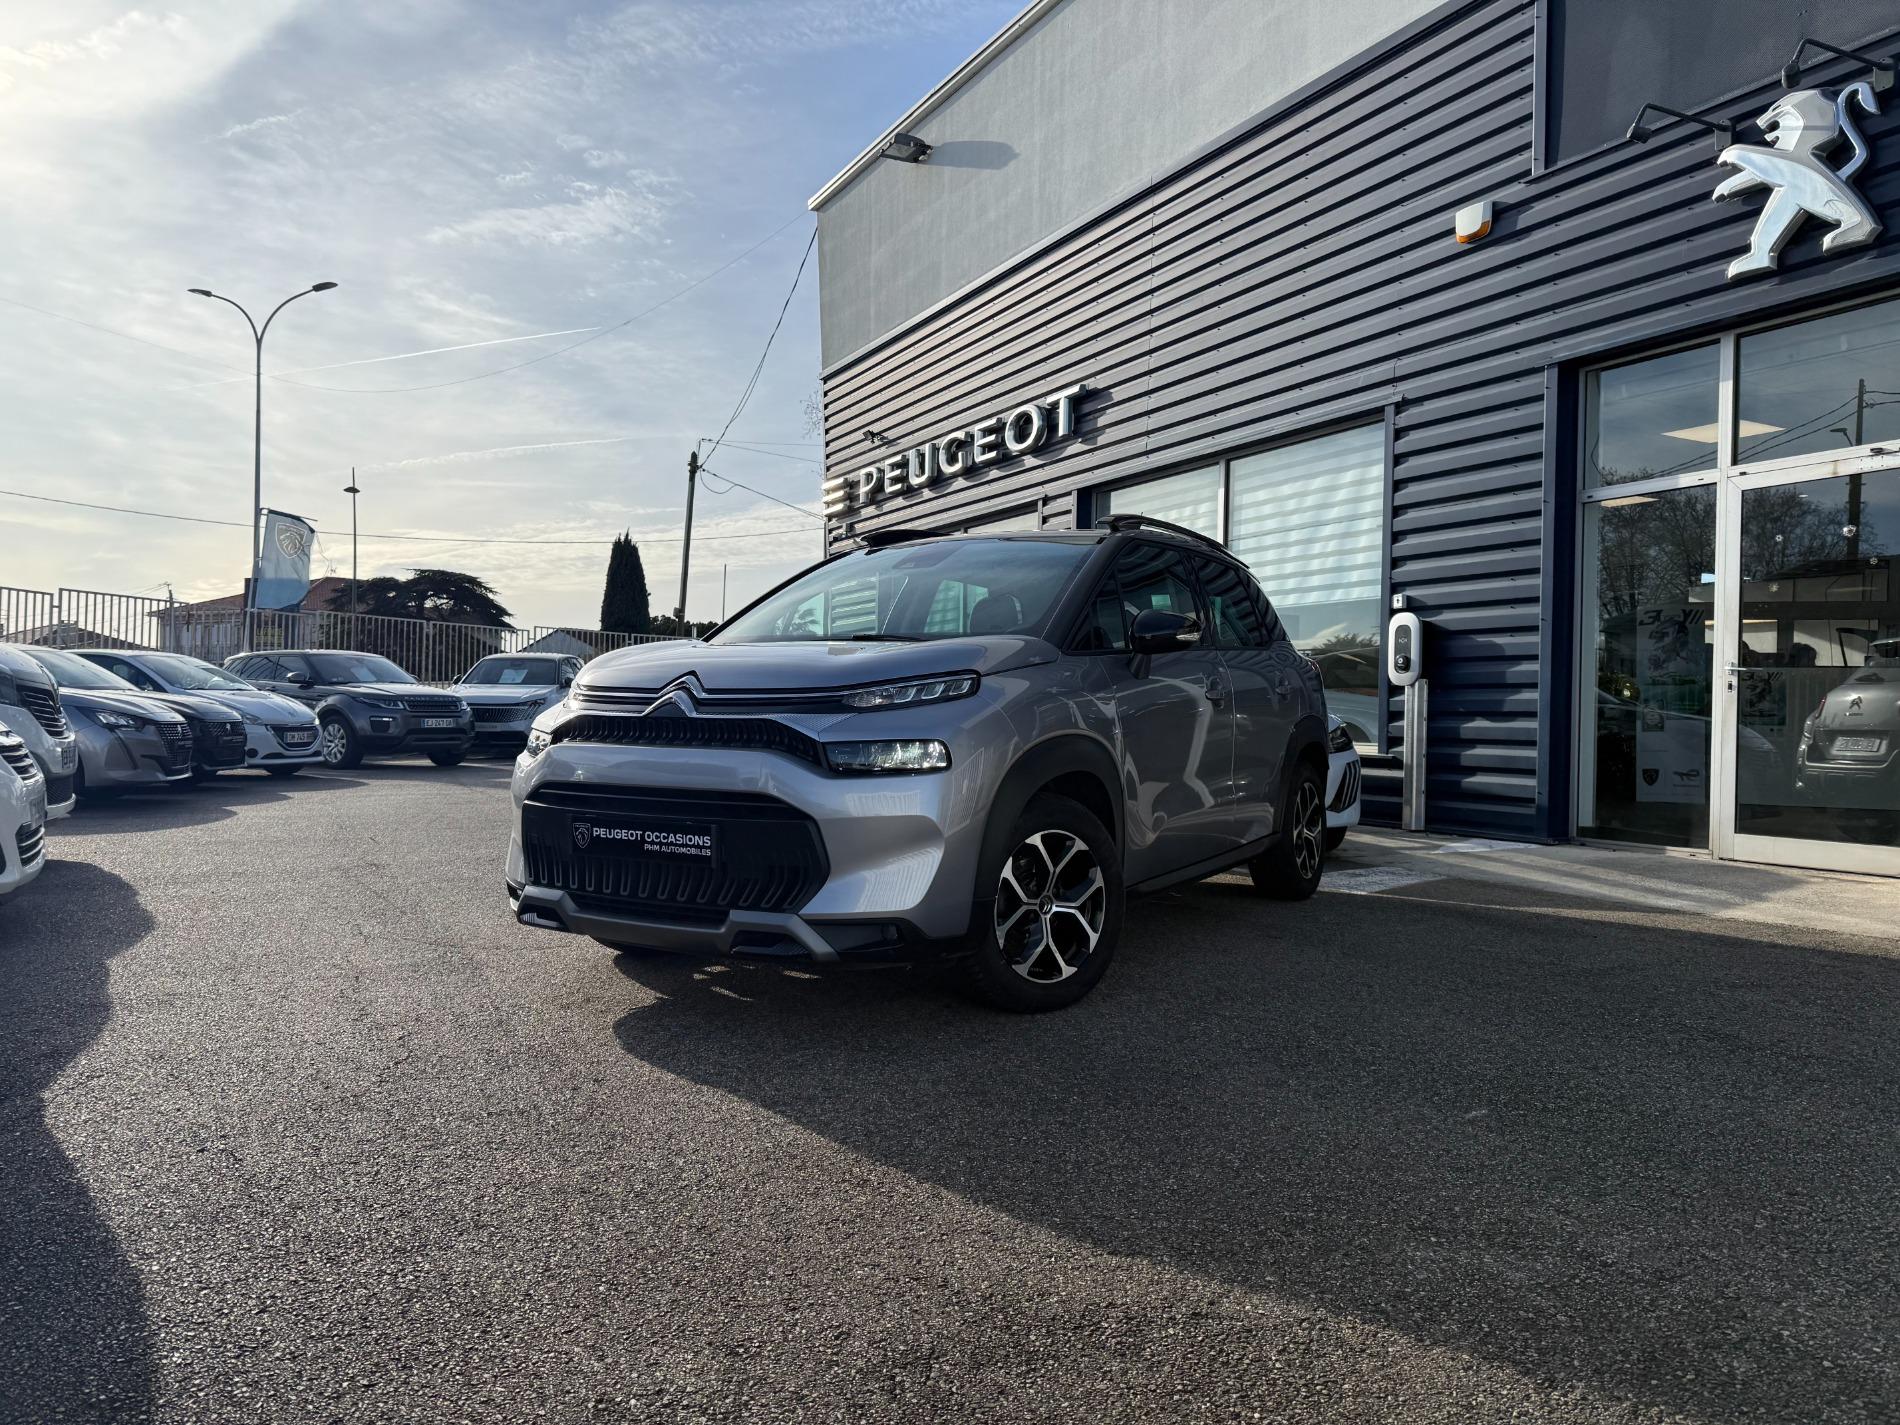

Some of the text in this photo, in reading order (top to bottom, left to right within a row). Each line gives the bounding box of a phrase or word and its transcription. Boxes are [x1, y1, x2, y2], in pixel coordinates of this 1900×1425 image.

[859, 383, 1090, 504] PEUGEOT
[593, 827, 711, 846] PEUGEOT OCCASIONS
[644, 843, 711, 856] PHM AUTOMOBILES
